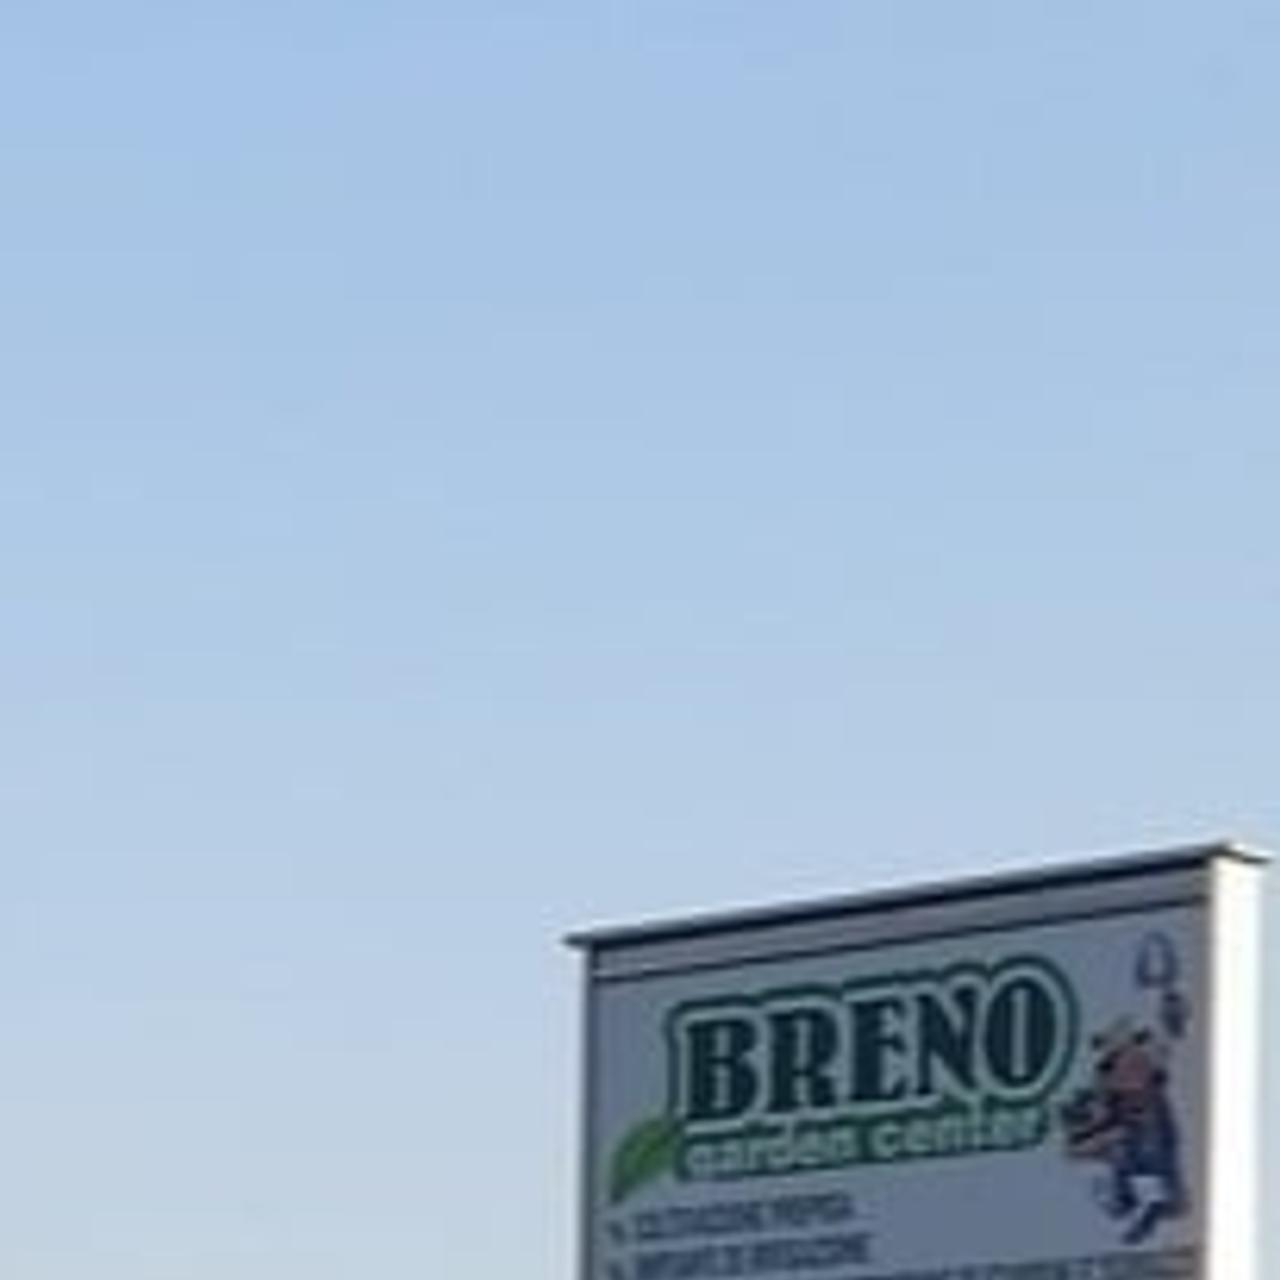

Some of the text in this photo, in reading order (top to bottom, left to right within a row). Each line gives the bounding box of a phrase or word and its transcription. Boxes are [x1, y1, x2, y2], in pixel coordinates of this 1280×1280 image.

[683, 974, 1059, 1122] BRENO
[683, 1102, 1042, 1177] garden center
